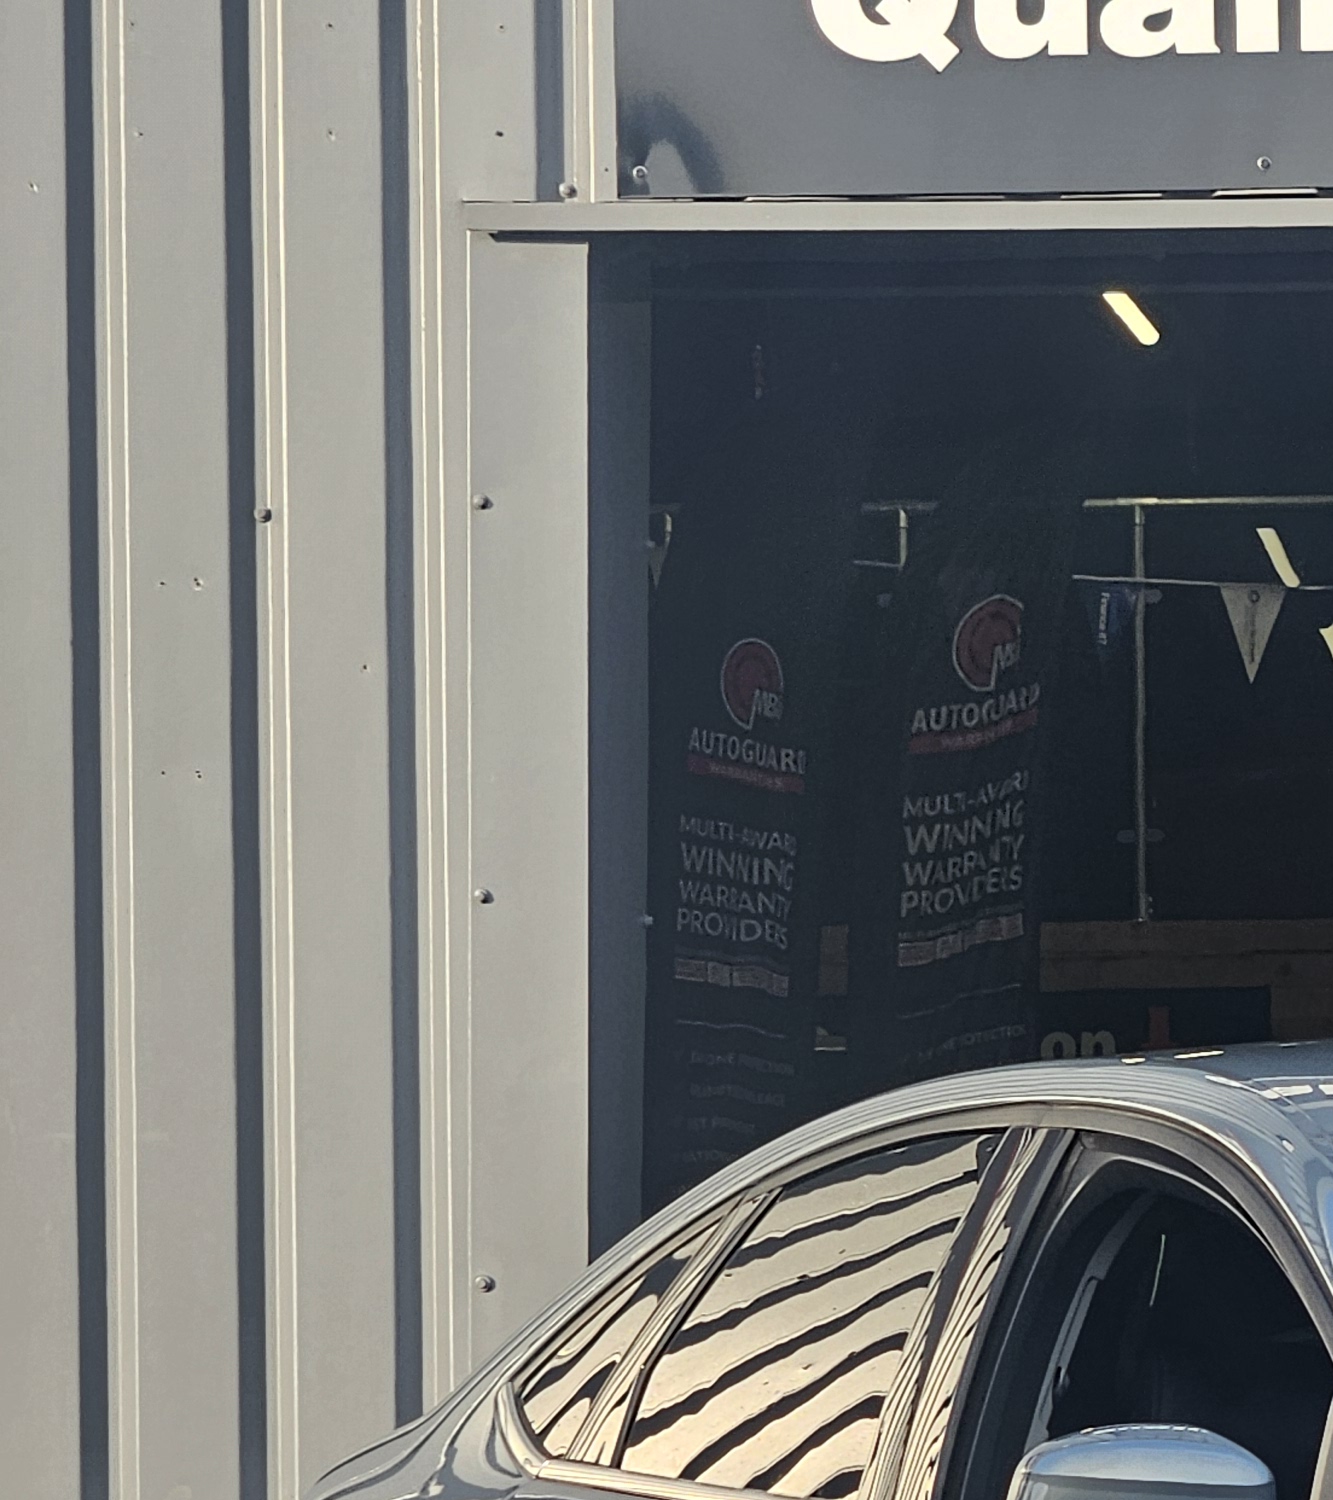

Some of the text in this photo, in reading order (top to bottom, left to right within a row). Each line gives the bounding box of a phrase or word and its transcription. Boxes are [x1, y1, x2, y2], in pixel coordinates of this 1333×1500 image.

[904, 799, 1025, 857] WINNNG
[901, 864, 1023, 919] PROVDES
[676, 906, 789, 951] PROVIDES
